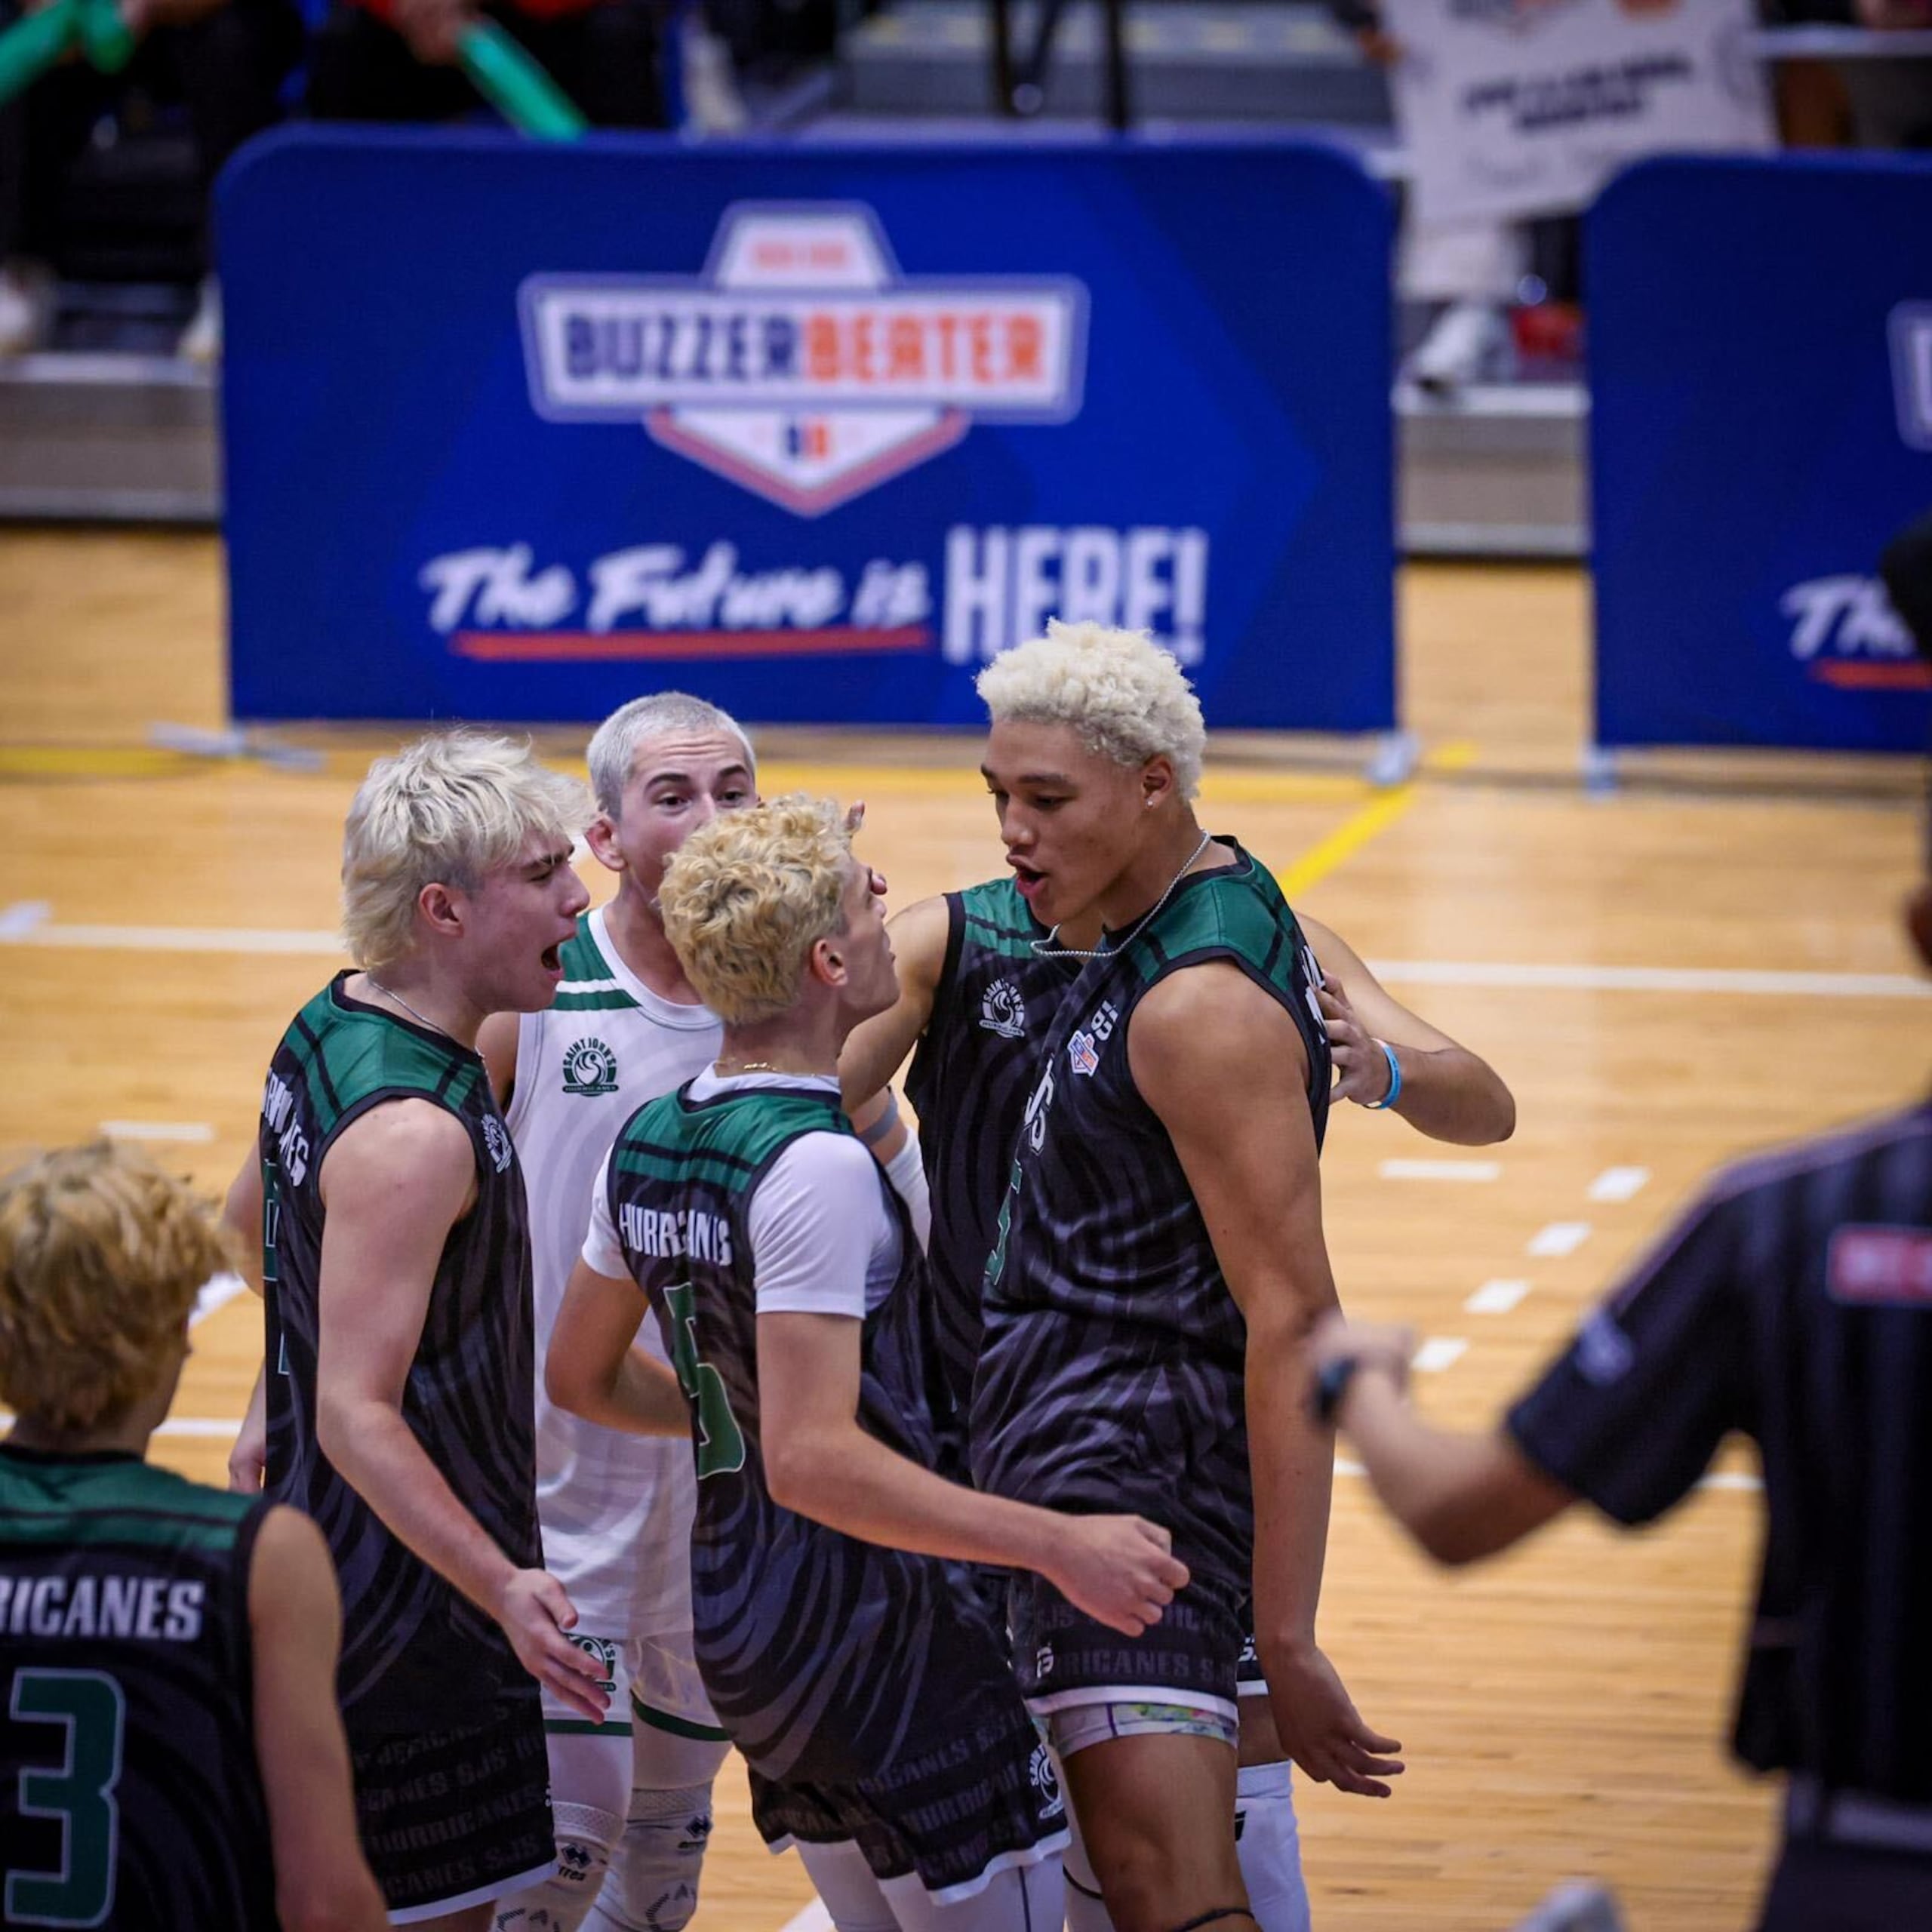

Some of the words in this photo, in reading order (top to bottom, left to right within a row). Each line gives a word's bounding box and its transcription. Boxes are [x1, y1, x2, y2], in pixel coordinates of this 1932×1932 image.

[421, 542, 576, 632] The
[590, 540, 844, 634] Future
[851, 558, 930, 629] is
[945, 525, 1207, 664] HERE!
[5, 1667, 126, 1929] 3
